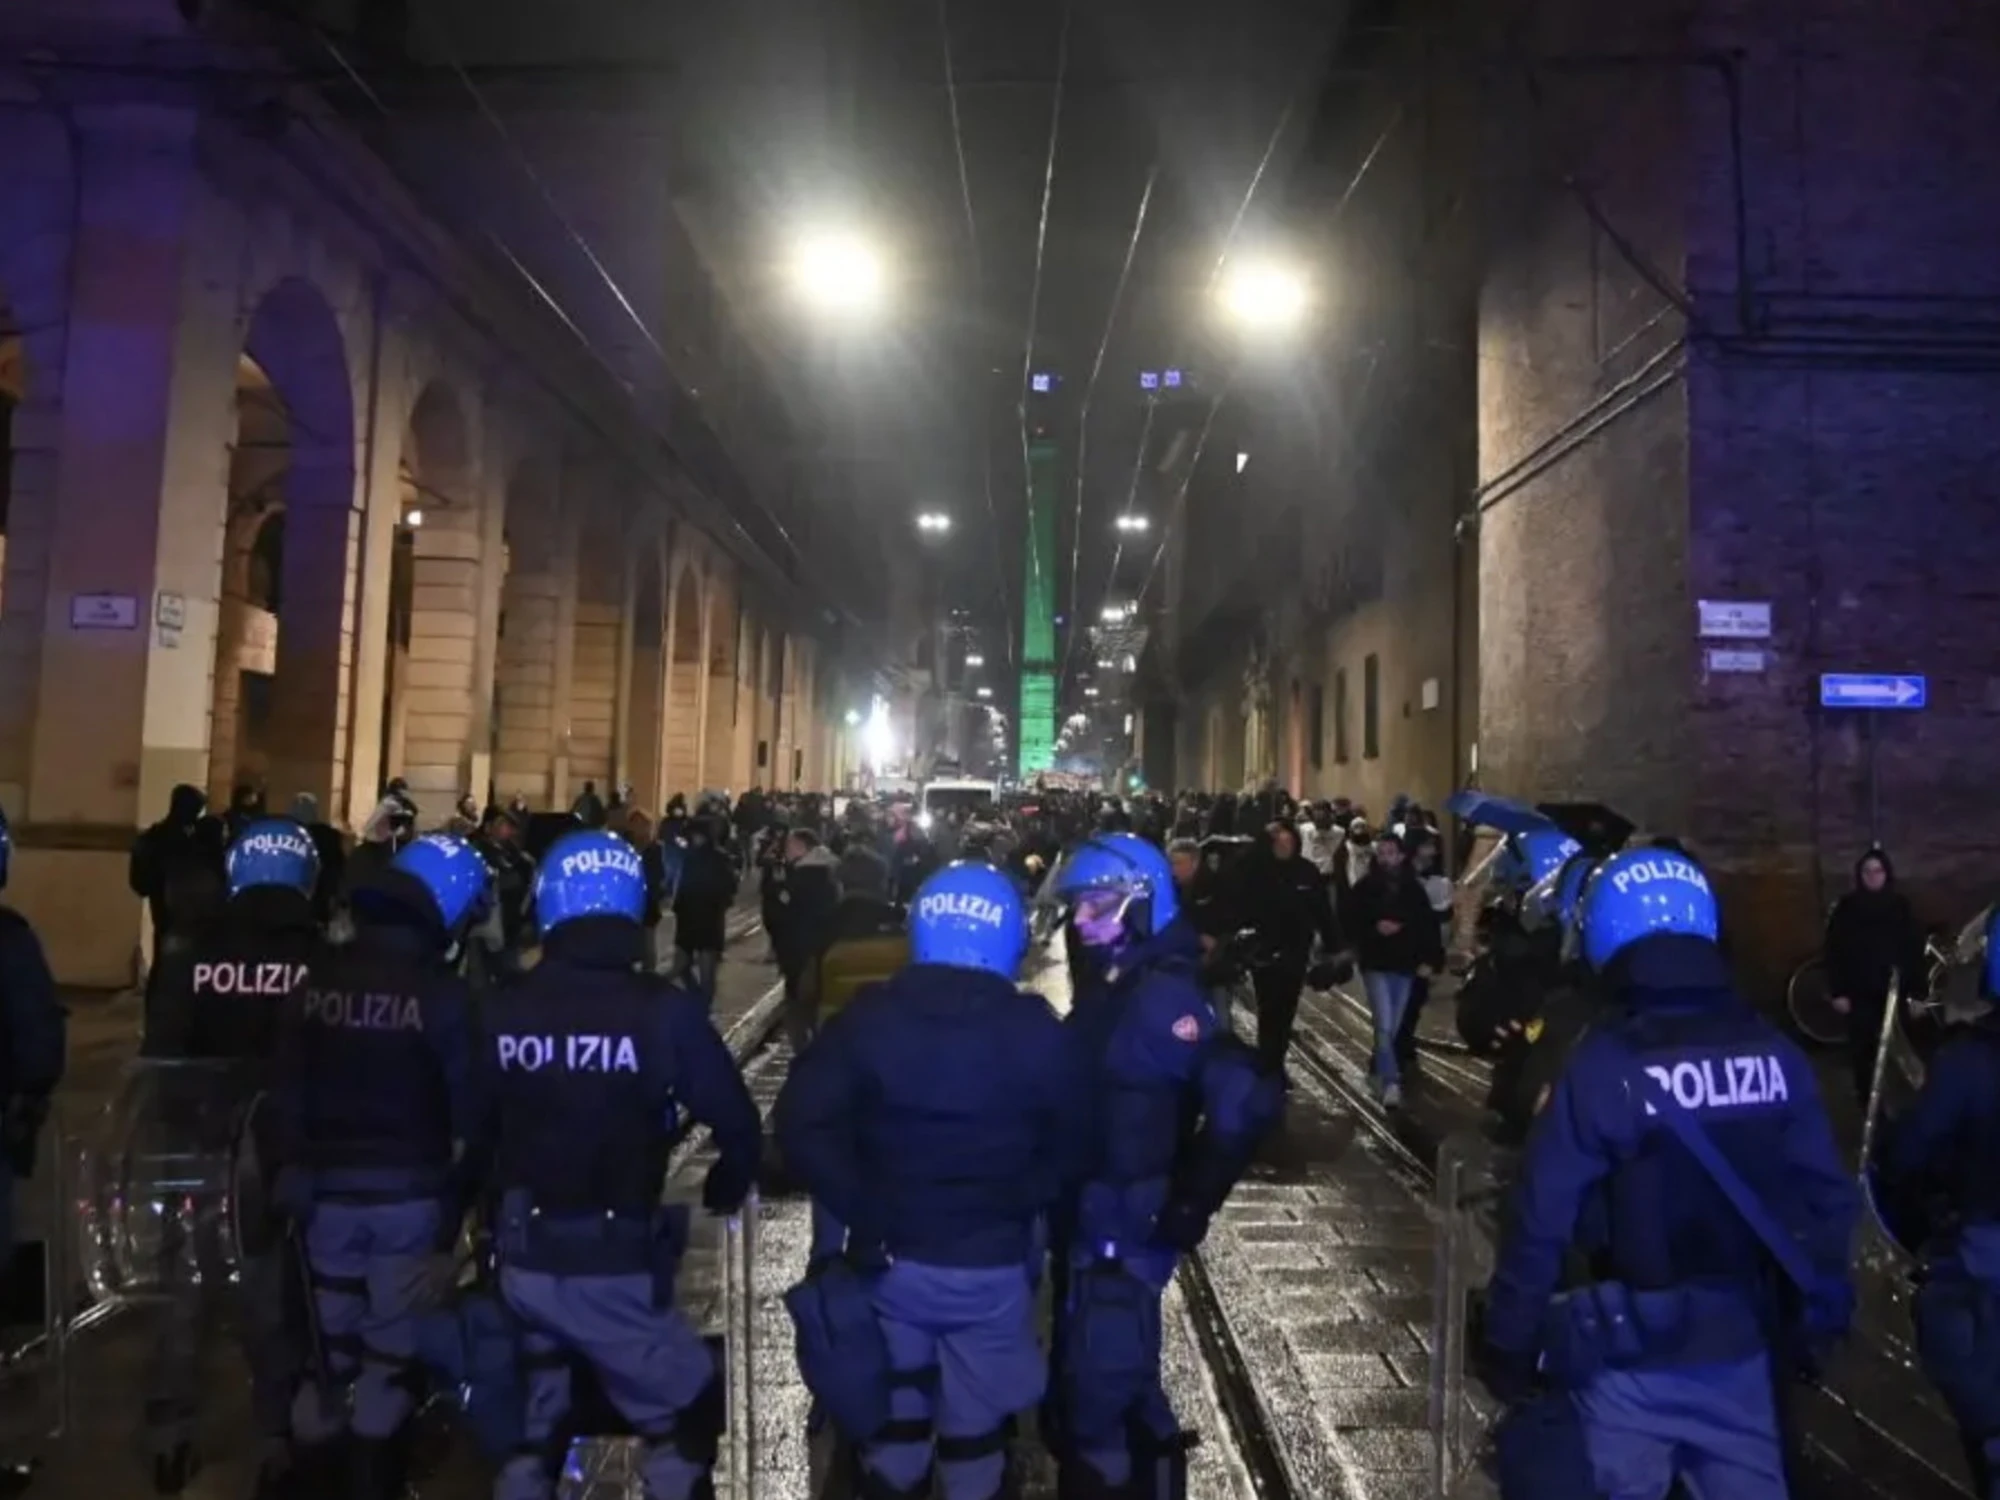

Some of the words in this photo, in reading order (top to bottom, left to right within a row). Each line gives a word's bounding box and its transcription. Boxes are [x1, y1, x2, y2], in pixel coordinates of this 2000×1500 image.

[243, 834, 307, 857] POLIZIA
[562, 848, 640, 878] POLIZIA
[1612, 859, 1709, 895] POLIZIA
[920, 892, 1003, 928] POLIZIA
[304, 990, 423, 1032] POLIZIA
